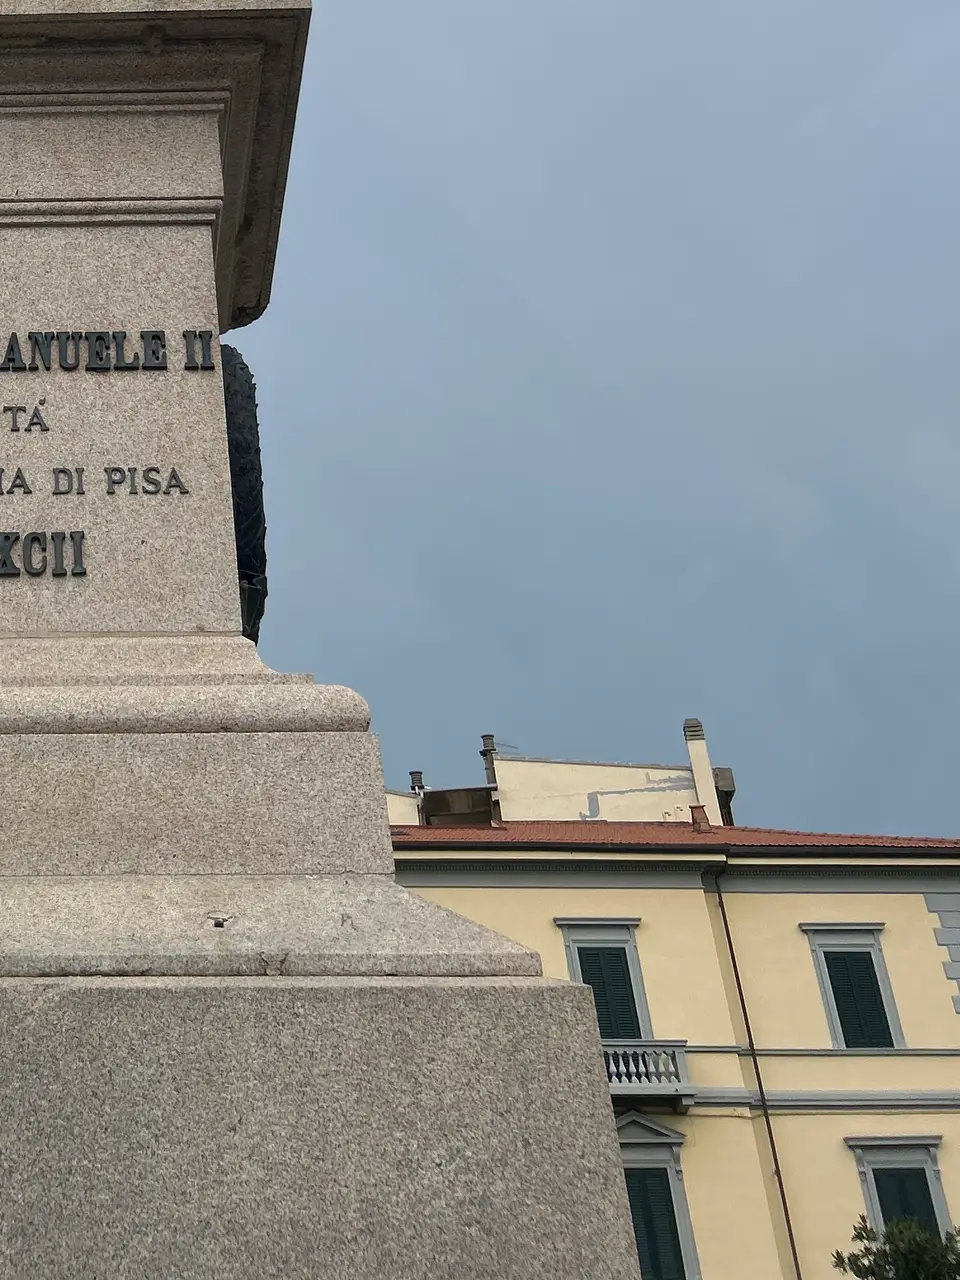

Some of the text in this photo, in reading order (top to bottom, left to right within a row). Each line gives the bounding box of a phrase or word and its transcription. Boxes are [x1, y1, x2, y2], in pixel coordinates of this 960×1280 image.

[183, 330, 215, 371] II
[51, 467, 85, 495] DI
[104, 467, 189, 495] PISA
